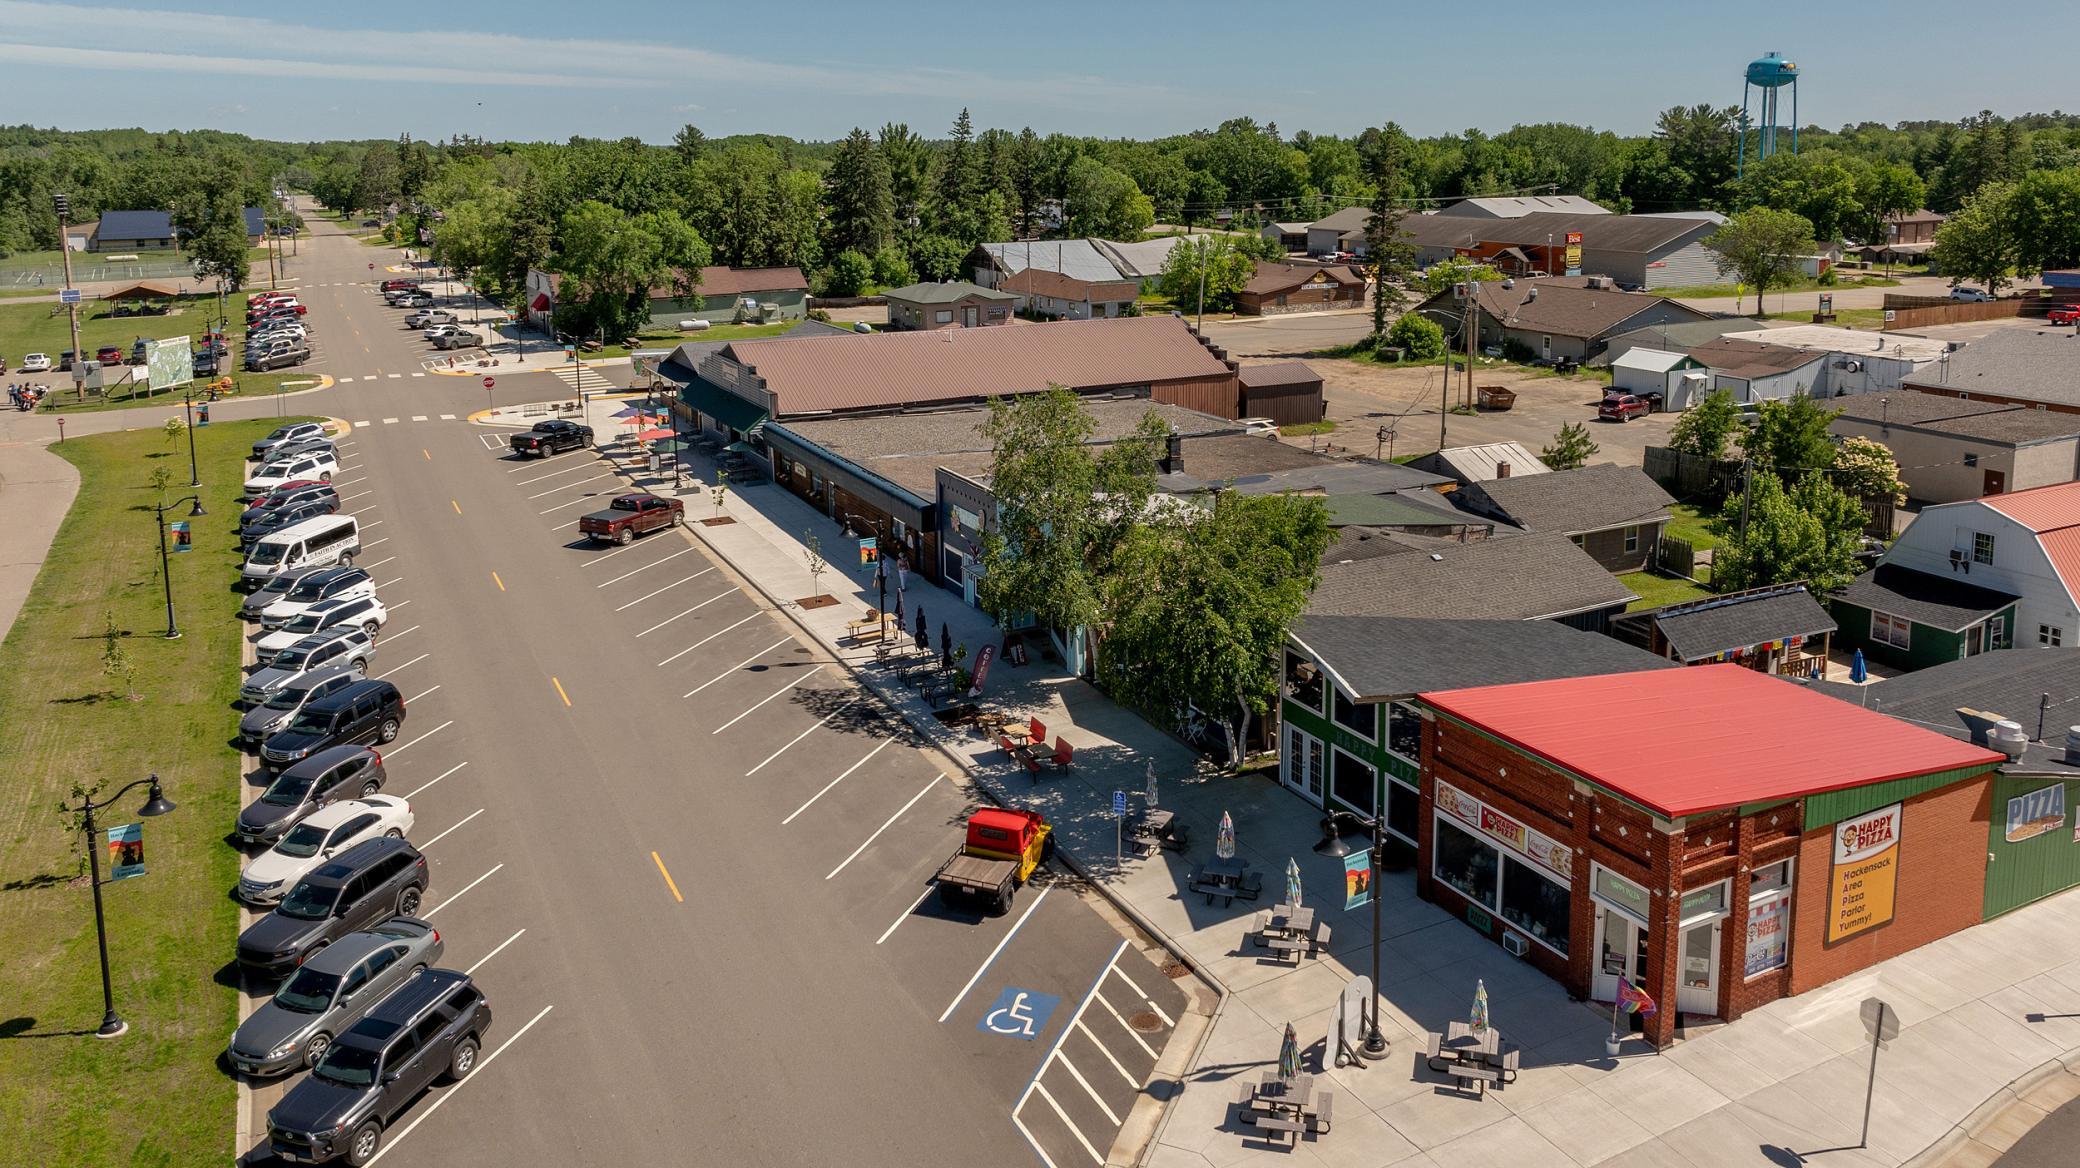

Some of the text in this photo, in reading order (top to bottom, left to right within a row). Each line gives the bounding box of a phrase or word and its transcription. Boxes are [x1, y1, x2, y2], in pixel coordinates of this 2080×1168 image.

[1336, 731, 1420, 787] HAPPY PIZZ
[2008, 784, 2064, 825] PIZZA
[1495, 814, 1520, 833] HAPPY
[1857, 812, 1894, 837] HAPPY
[1857, 827, 1894, 850] PIZZA
[1843, 857, 1891, 881] Hackensack
[1842, 879, 1863, 894] Area
[1842, 891, 1865, 906] Pizza
[1839, 911, 1873, 932] Yummy!
[1840, 903, 1866, 920] Parlor
[1756, 915, 1781, 929] HAPPY
[1757, 924, 1782, 939] PIZZA
